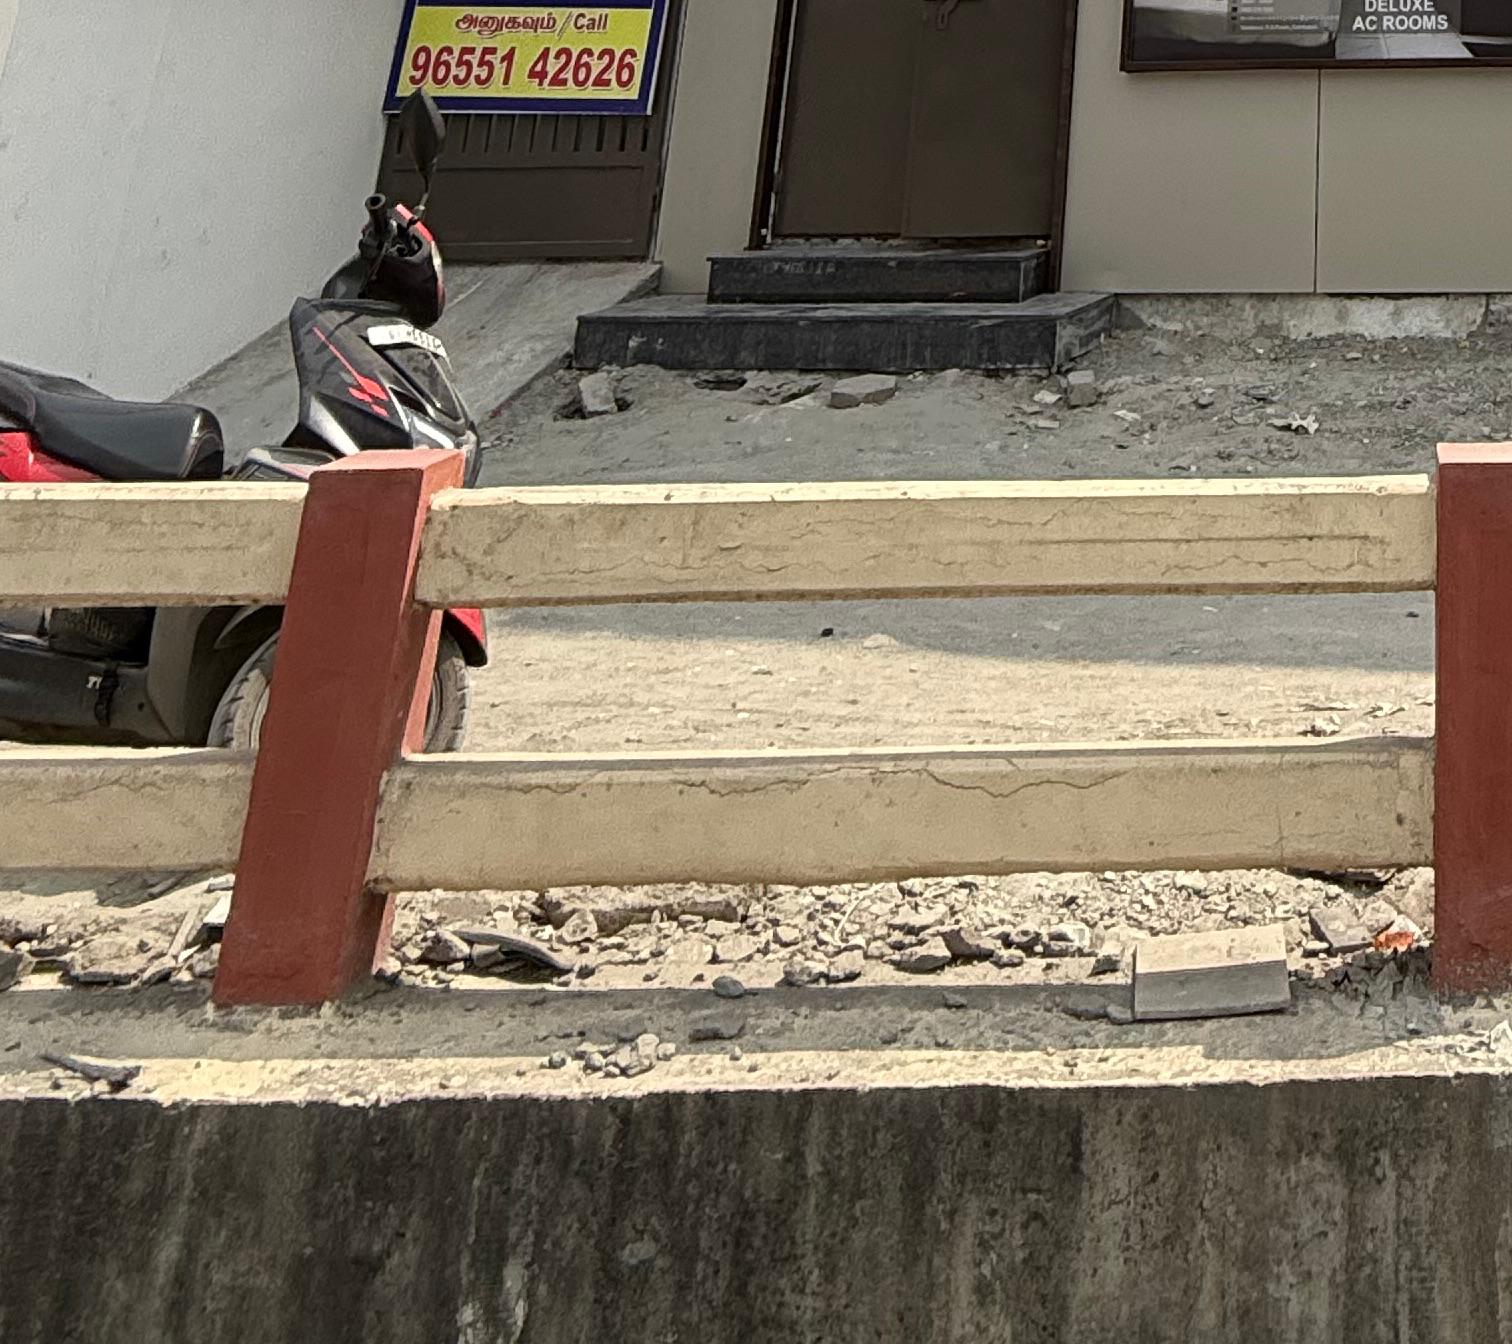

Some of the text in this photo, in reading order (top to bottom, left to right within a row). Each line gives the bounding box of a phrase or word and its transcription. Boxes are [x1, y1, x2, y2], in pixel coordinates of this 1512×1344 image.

[1352, 14, 1449, 31] AC ROOMS
[408, 45, 639, 90] 96551 42626
